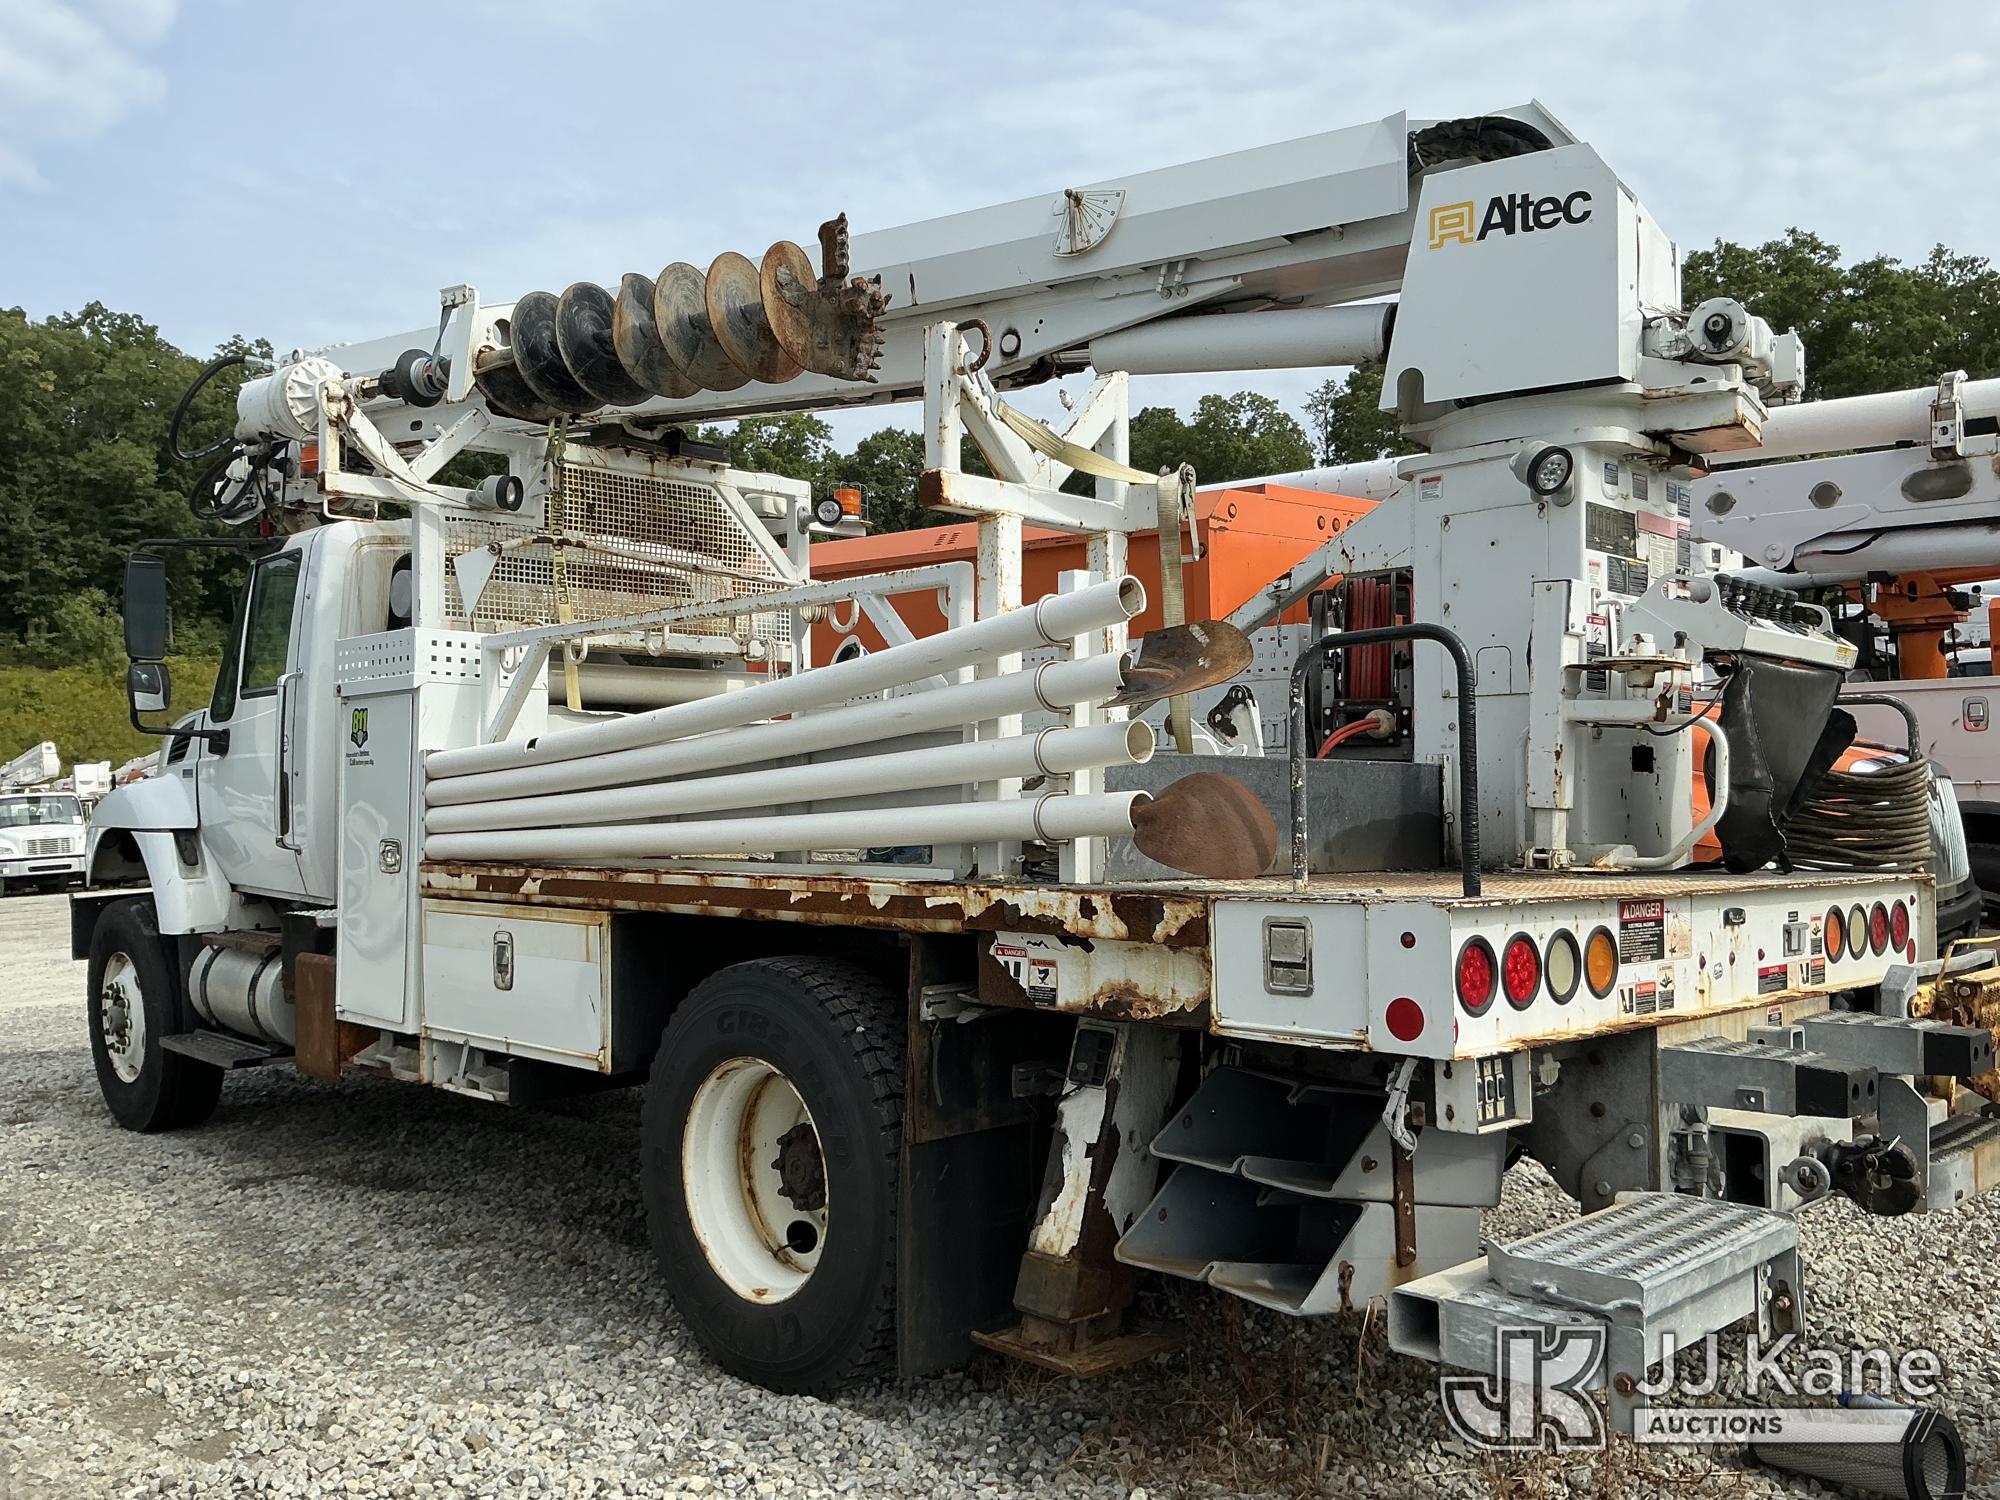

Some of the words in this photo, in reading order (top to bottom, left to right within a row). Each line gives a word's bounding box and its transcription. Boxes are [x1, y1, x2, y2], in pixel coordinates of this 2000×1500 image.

[1476, 190, 1592, 241] Altec
[552, 529, 563, 558] LOD
[352, 708, 368, 734] 811
[1630, 903, 1661, 918] DANGER
[717, 1010, 790, 1049] G182
